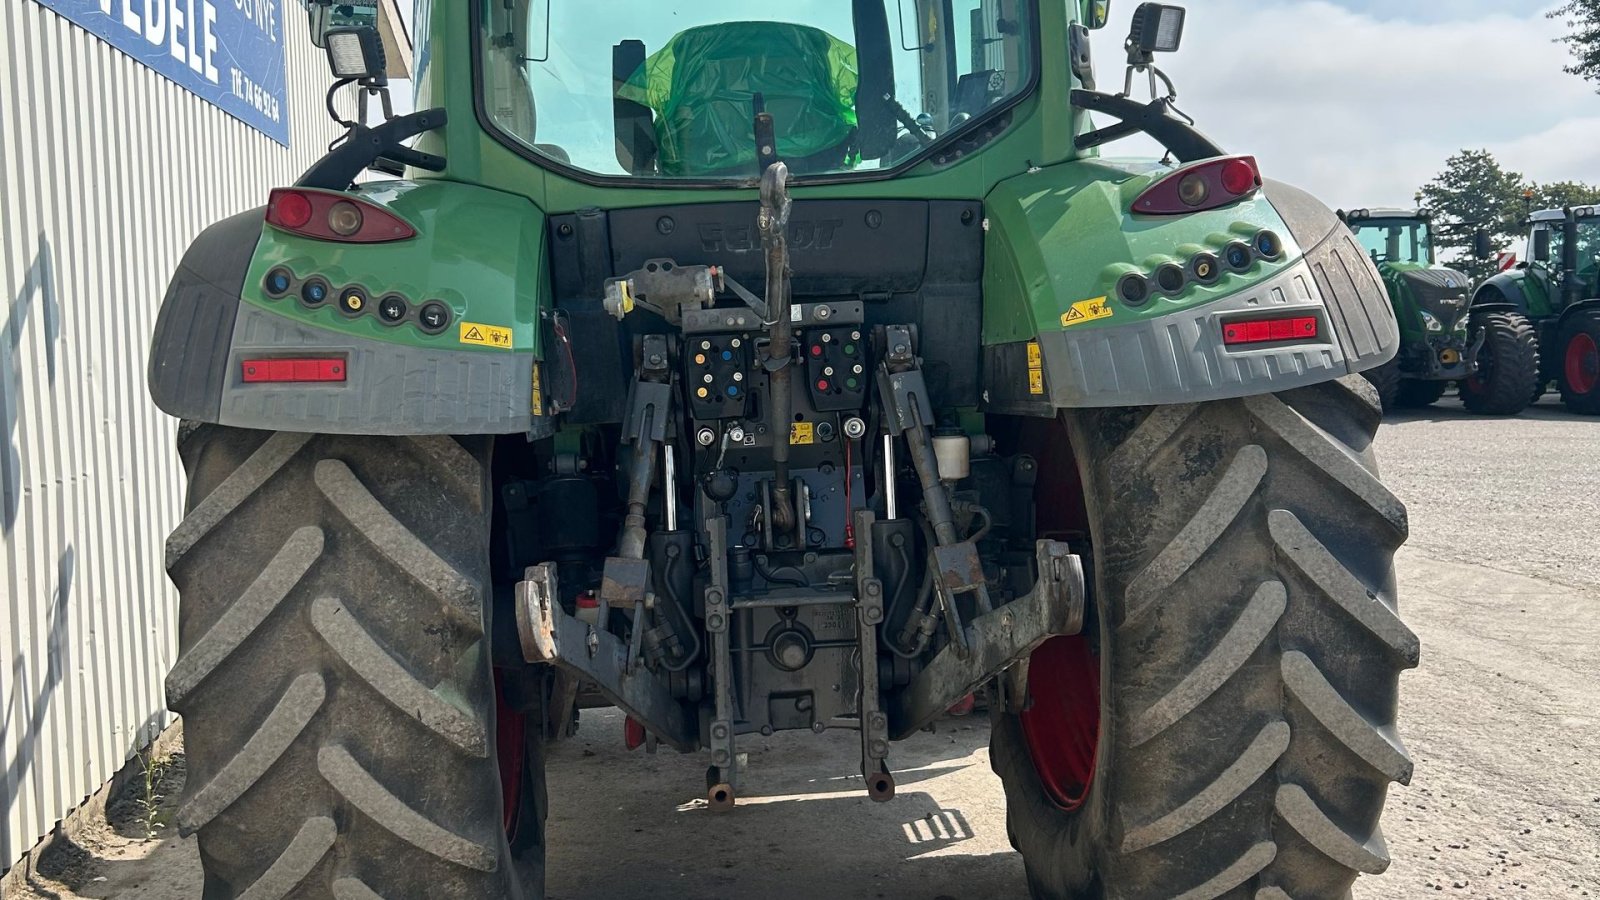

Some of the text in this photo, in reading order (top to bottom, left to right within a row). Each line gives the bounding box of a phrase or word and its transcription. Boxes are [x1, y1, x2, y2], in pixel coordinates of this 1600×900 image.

[100, 0, 219, 84] DELE
[255, 0, 276, 42] NYE
[230, 67, 244, 99] Tlf.
[244, 77, 253, 105] 74
[254, 84, 262, 112] 66
[263, 91, 271, 118] 92
[697, 219, 843, 253] FEDT
